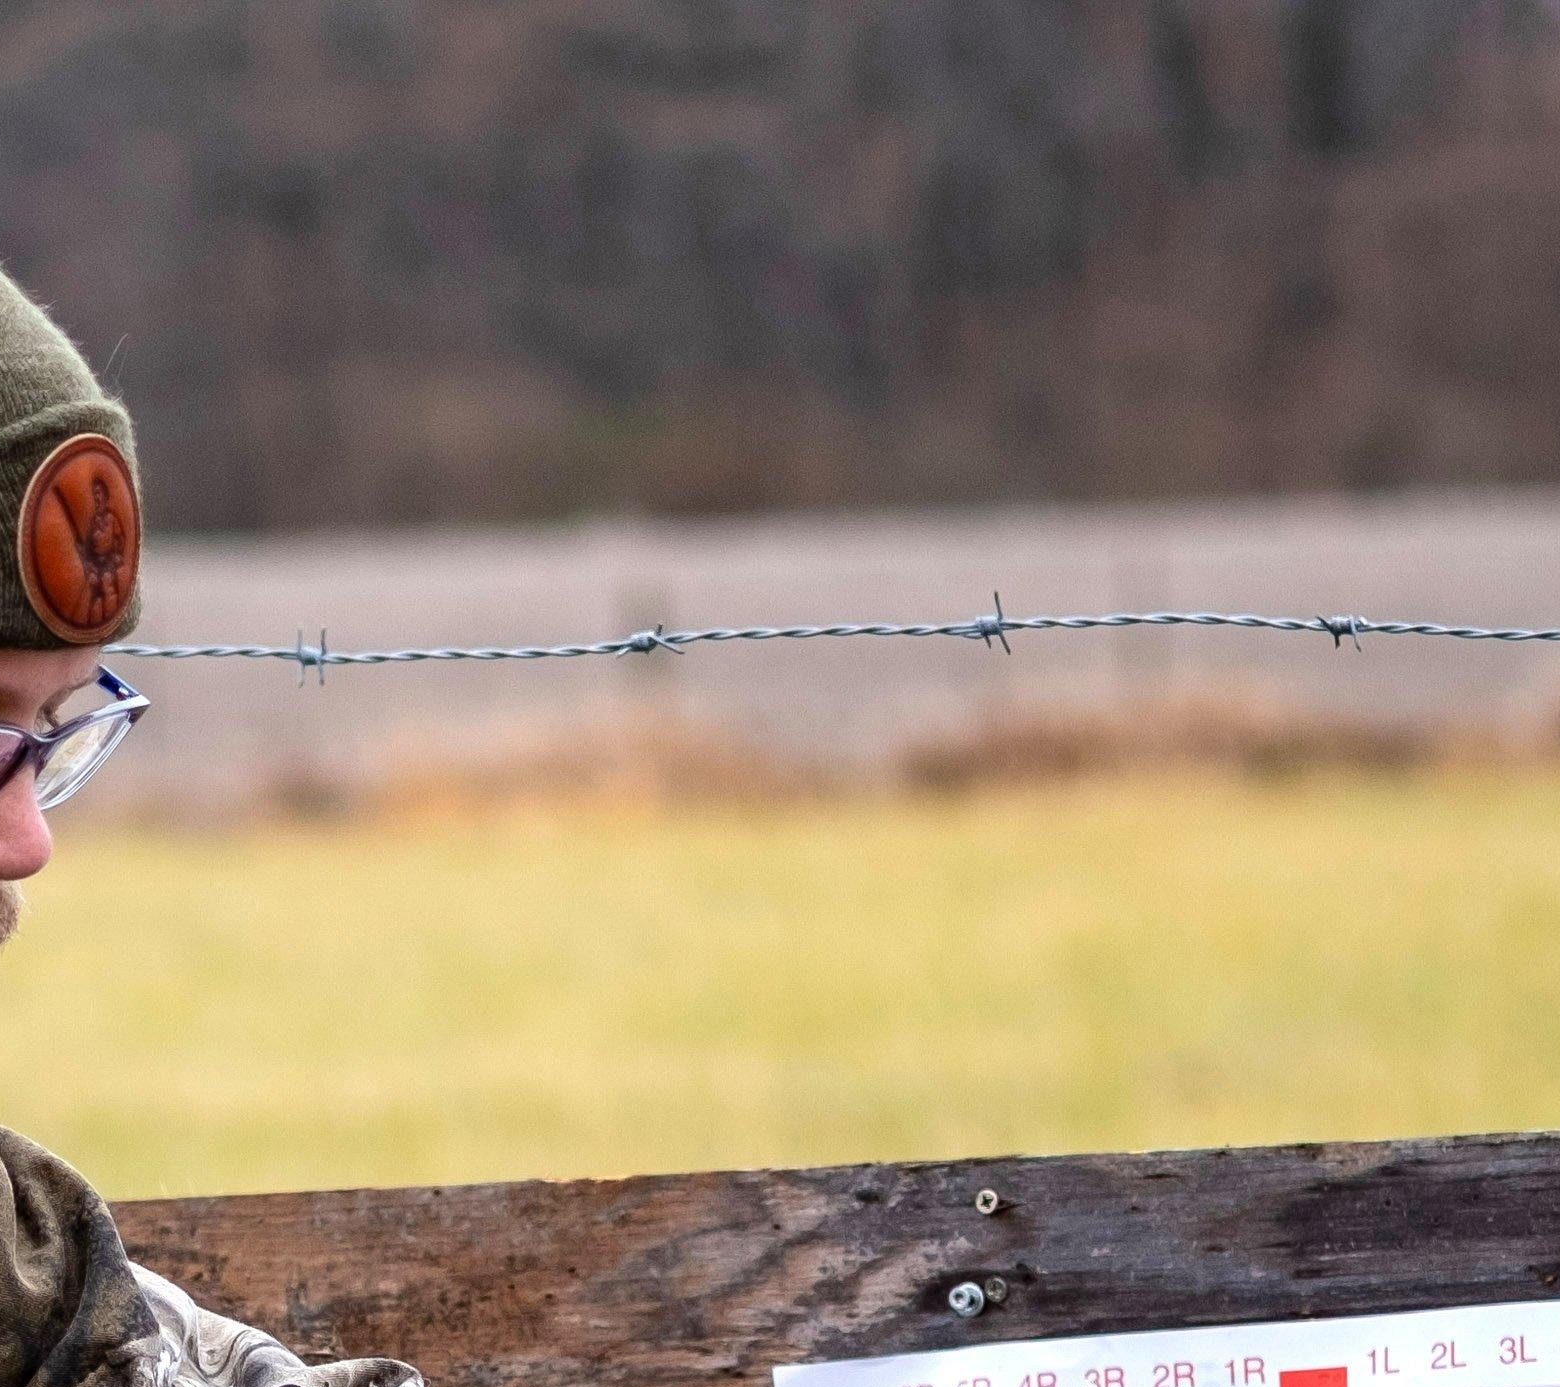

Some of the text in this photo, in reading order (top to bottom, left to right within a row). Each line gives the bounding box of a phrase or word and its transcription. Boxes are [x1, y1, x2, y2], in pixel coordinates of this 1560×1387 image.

[1225, 1358, 1265, 1385] 1R
[1368, 1347, 1400, 1374] 1L
[1431, 1341, 1466, 1369] 2L
[1500, 1336, 1536, 1364] 3L
